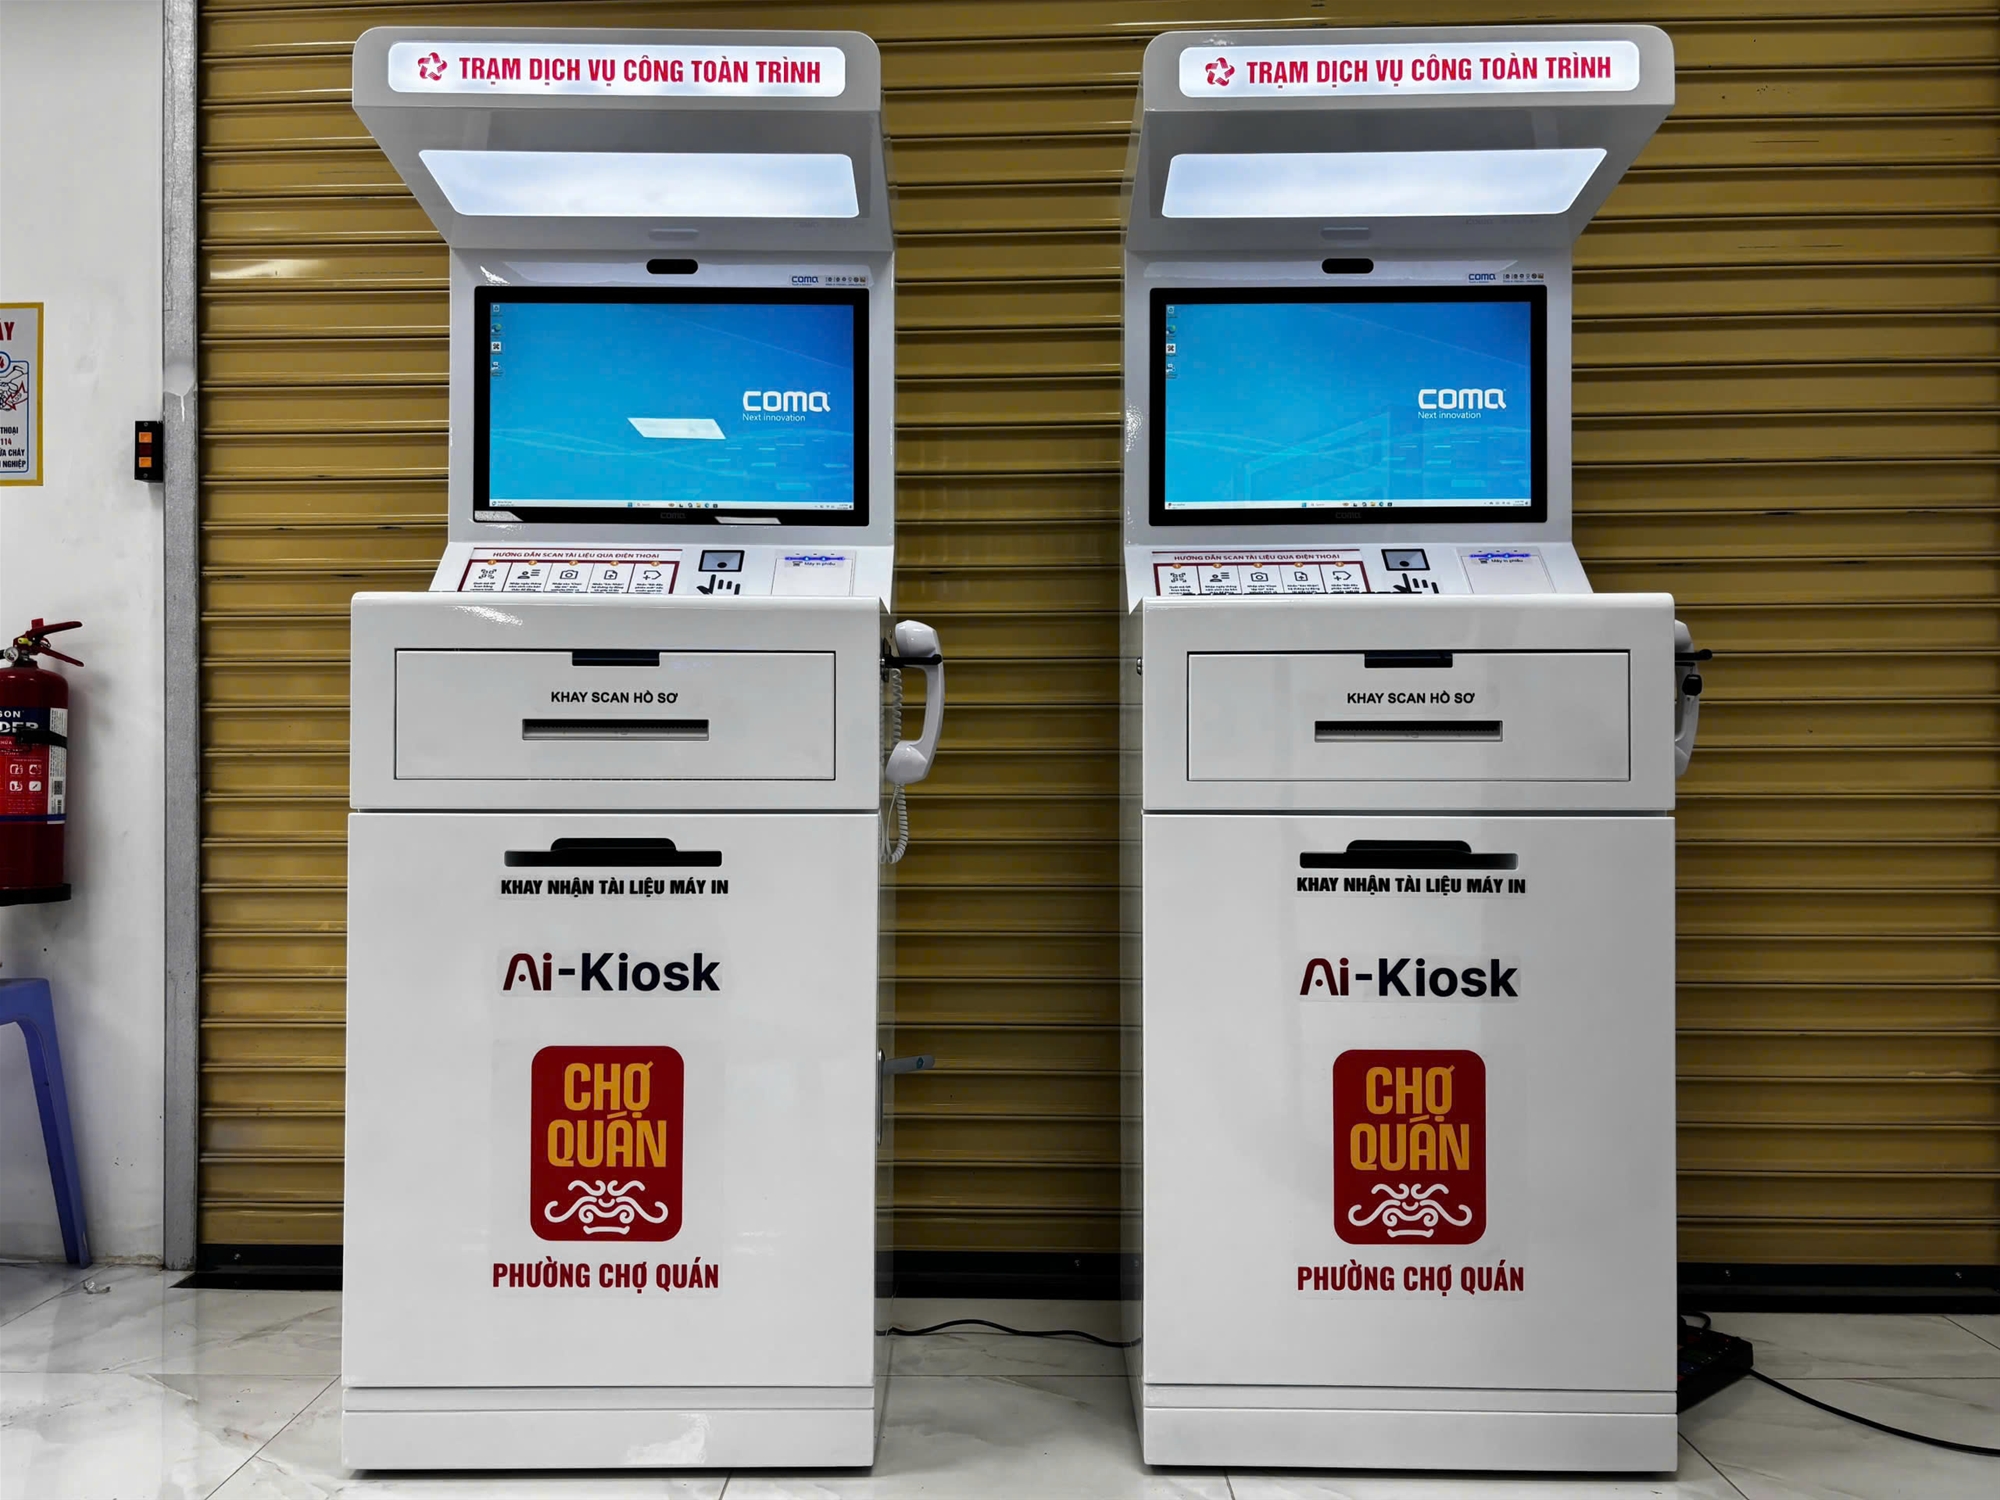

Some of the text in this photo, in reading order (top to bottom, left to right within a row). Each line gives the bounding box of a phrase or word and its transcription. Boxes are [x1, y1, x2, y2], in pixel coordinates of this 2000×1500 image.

[459, 55, 820, 87] TRẠM DỊCH VỤ CÔNG TOÀN TRÌNH
[1247, 52, 1611, 88] TRẠM DỊCH VỤ CÔNG TOÀN TRÌNH
[743, 391, 831, 412] coma
[1418, 388, 1507, 409] coma
[1418, 411, 1481, 419] Next innovation
[743, 413, 806, 421] Next innovation
[551, 691, 588, 703] KHAY
[591, 691, 629, 704] SCAN
[657, 691, 679, 704] SƠ
[1347, 692, 1384, 704] KHAY
[1387, 692, 1426, 704] SCAN
[1454, 692, 1475, 704] SƠ
[501, 877, 729, 898] KHAY NHẬN TÀI LIỆU MÁY IN
[1297, 874, 1526, 896] KHAY NHẬN TÀI LIỆU MÁY IN
[503, 952, 721, 992] Ai-Kiosk
[1300, 957, 1518, 998] Ai-Kiosk
[564, 1061, 654, 1119] CHỢ
[1366, 1064, 1456, 1122] CHỢ
[547, 1110, 667, 1168] QUÁN
[1350, 1114, 1470, 1171] QUÁN
[493, 1256, 719, 1294] PHƯỜNG CHỢ QUÁN
[1298, 1259, 1524, 1297] PHƯỜNG CHỢ QUÁN
